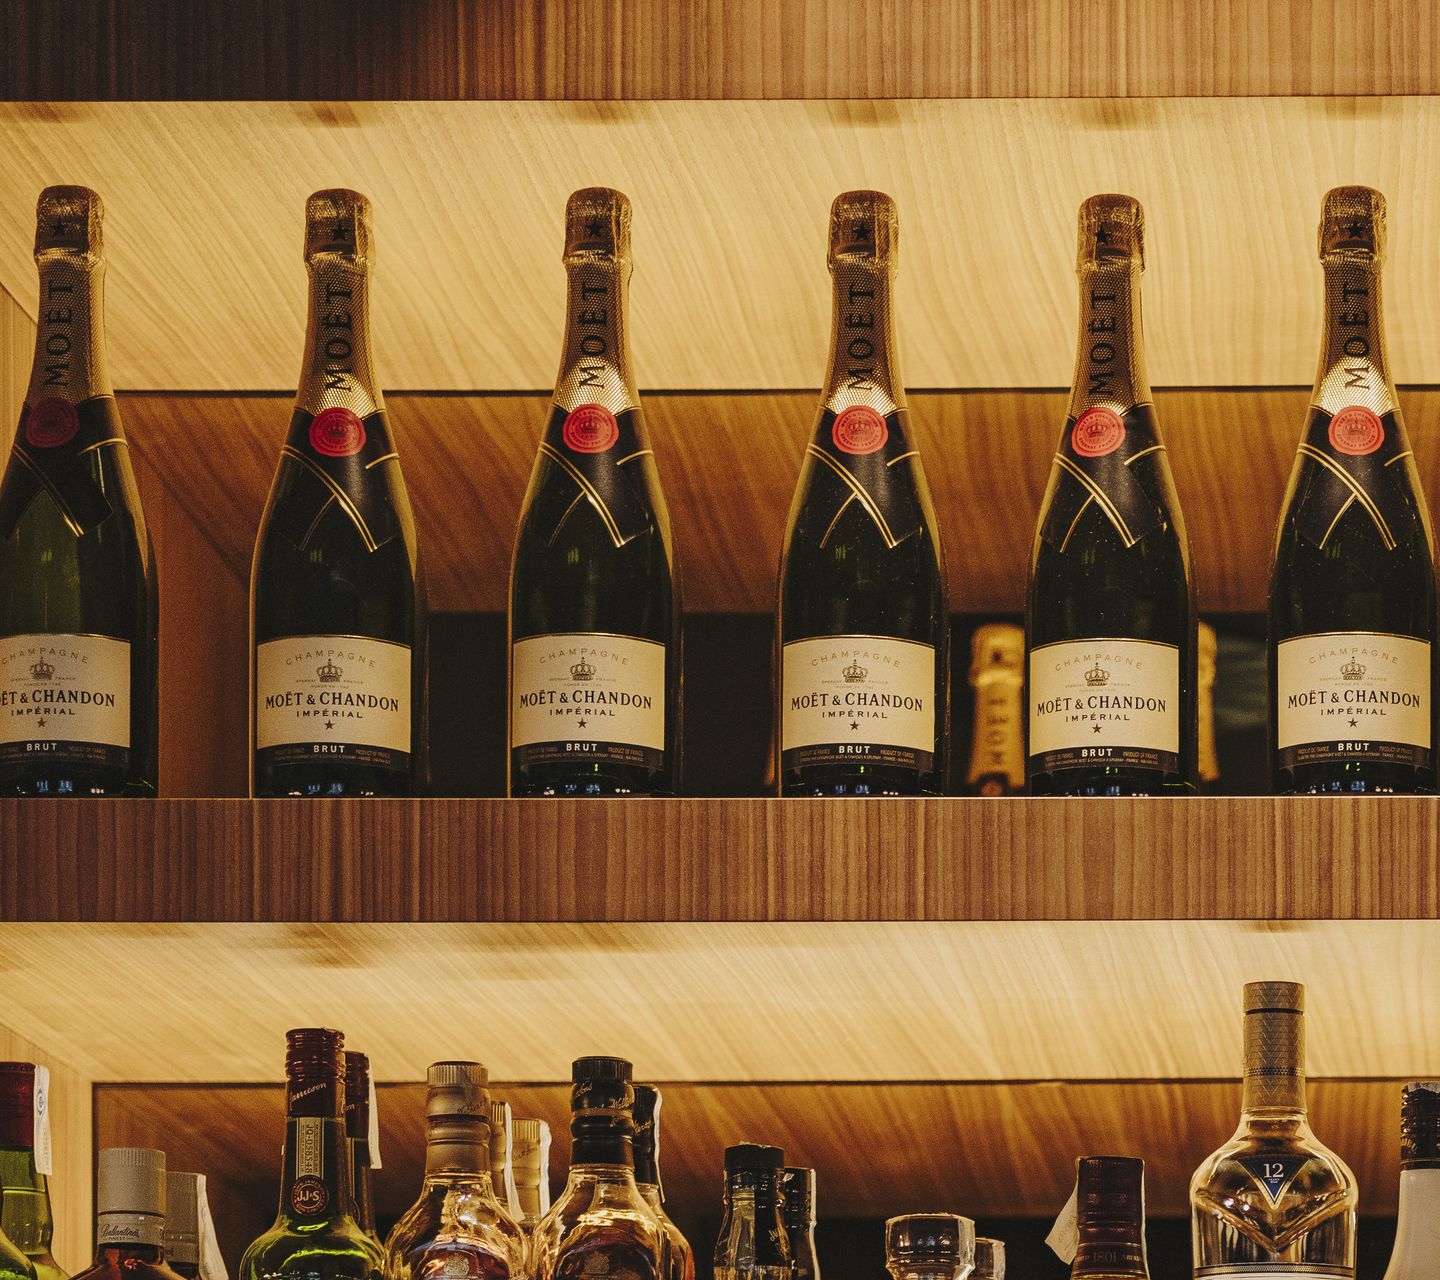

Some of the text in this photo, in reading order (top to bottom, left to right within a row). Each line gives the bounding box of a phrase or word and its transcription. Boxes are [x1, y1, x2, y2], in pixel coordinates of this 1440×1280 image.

[285, 650, 376, 669] CHAMPAGNE
[539, 648, 629, 667] CHAMPAGNE
[265, 690, 399, 712] MOËT & CHANDON
[520, 690, 653, 710] MOËT & CHANDON
[1288, 689, 1420, 709] MOËT & CHANDON
[296, 708, 364, 719] IMPÉRIAL
[549, 706, 616, 717] IMPÉRIAL
[1320, 706, 1387, 716] IMPÉRIAL
[313, 744, 346, 754] BRUT
[1337, 742, 1370, 752] BRUT
[1264, 1163, 1284, 1178] 12
